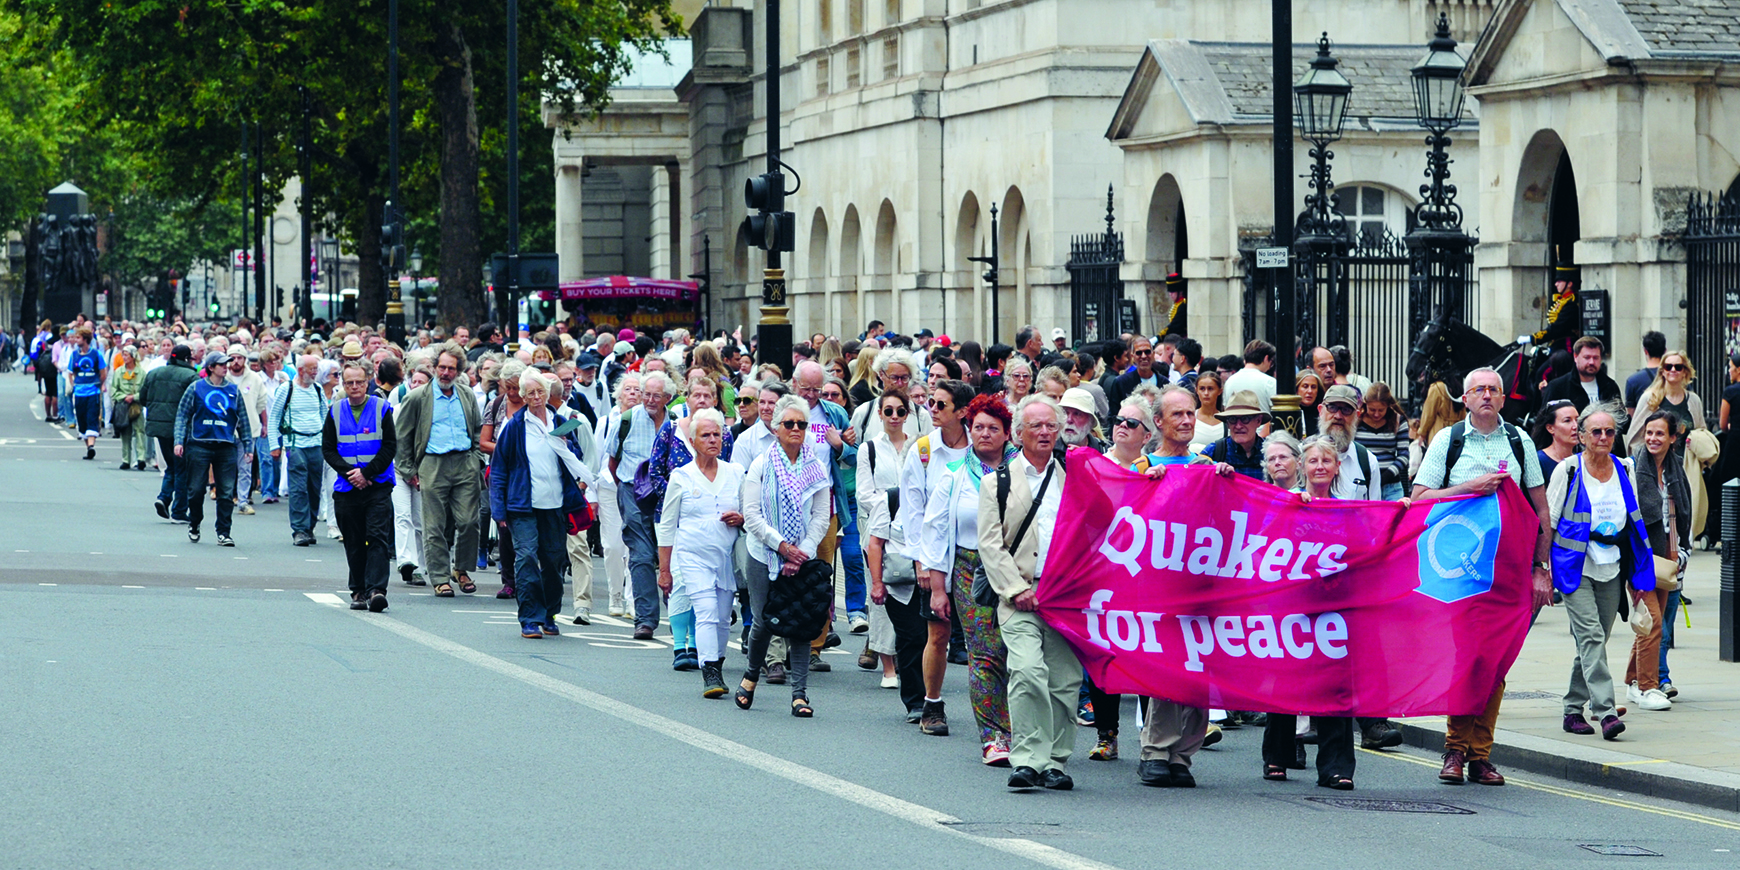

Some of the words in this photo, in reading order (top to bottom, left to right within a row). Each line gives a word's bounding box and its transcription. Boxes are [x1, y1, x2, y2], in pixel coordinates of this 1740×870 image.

[567, 288, 585, 296] BUY
[615, 287, 651, 295] TICKETS
[653, 288, 676, 296] HERE
[1099, 506, 1348, 582] Quakers
[1081, 589, 1166, 653] for
[1175, 611, 1349, 672] peace
